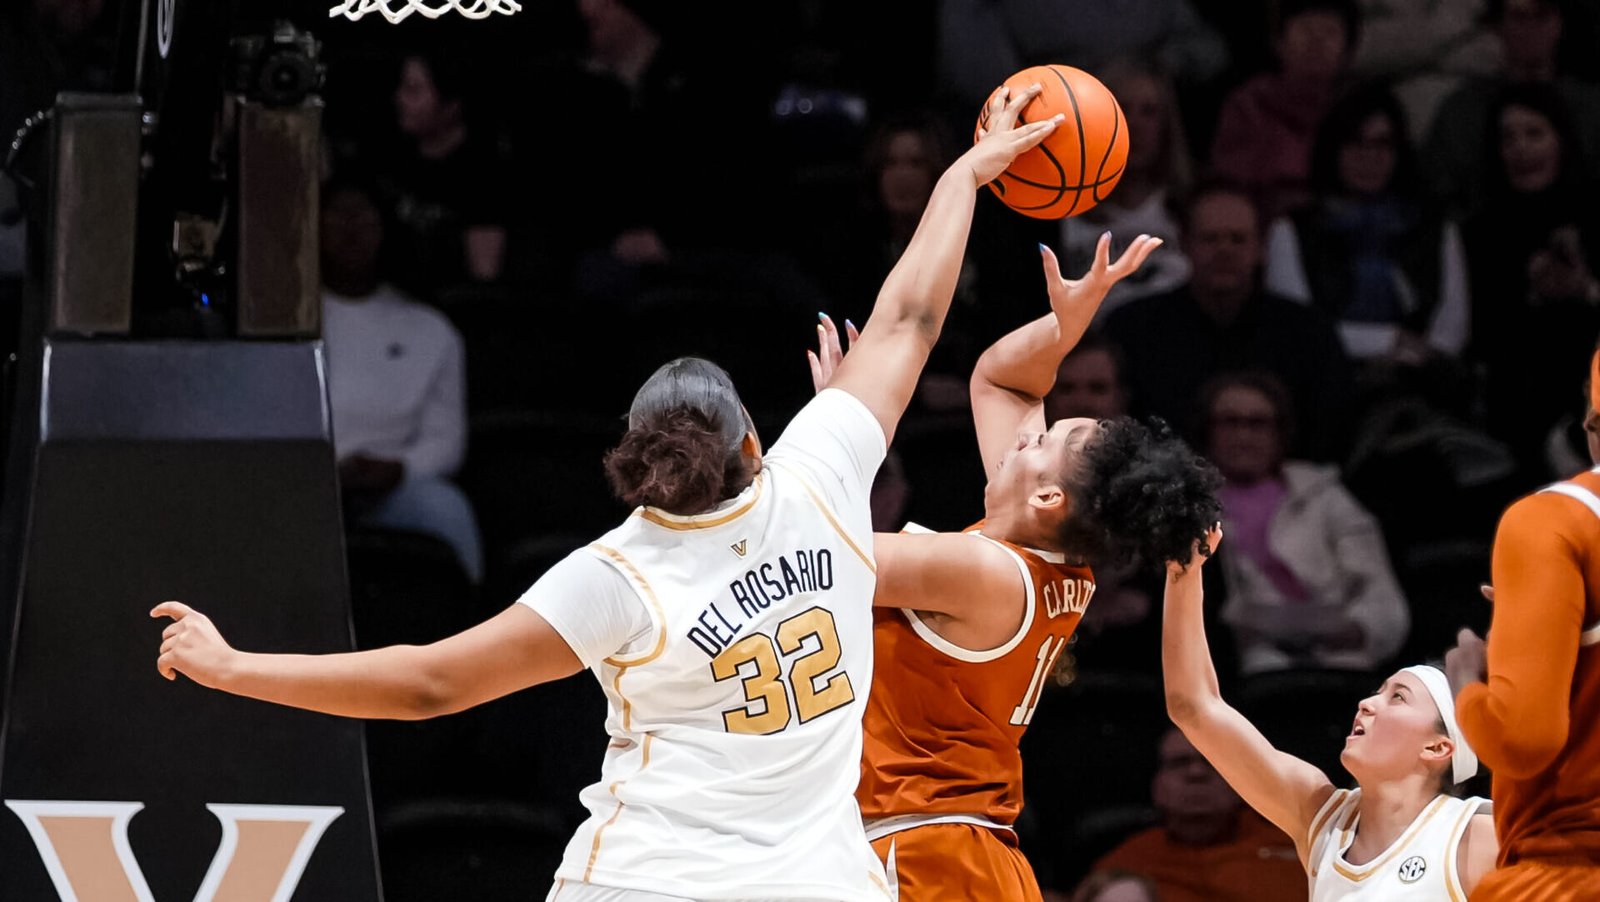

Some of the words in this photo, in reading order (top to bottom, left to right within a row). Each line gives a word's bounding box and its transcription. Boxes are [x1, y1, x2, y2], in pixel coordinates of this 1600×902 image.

[730, 538, 748, 559] V
[687, 602, 743, 660] DEL
[729, 548, 834, 619] ROSARIO
[710, 605, 855, 735] 32
[1399, 856, 1426, 883] SEC
